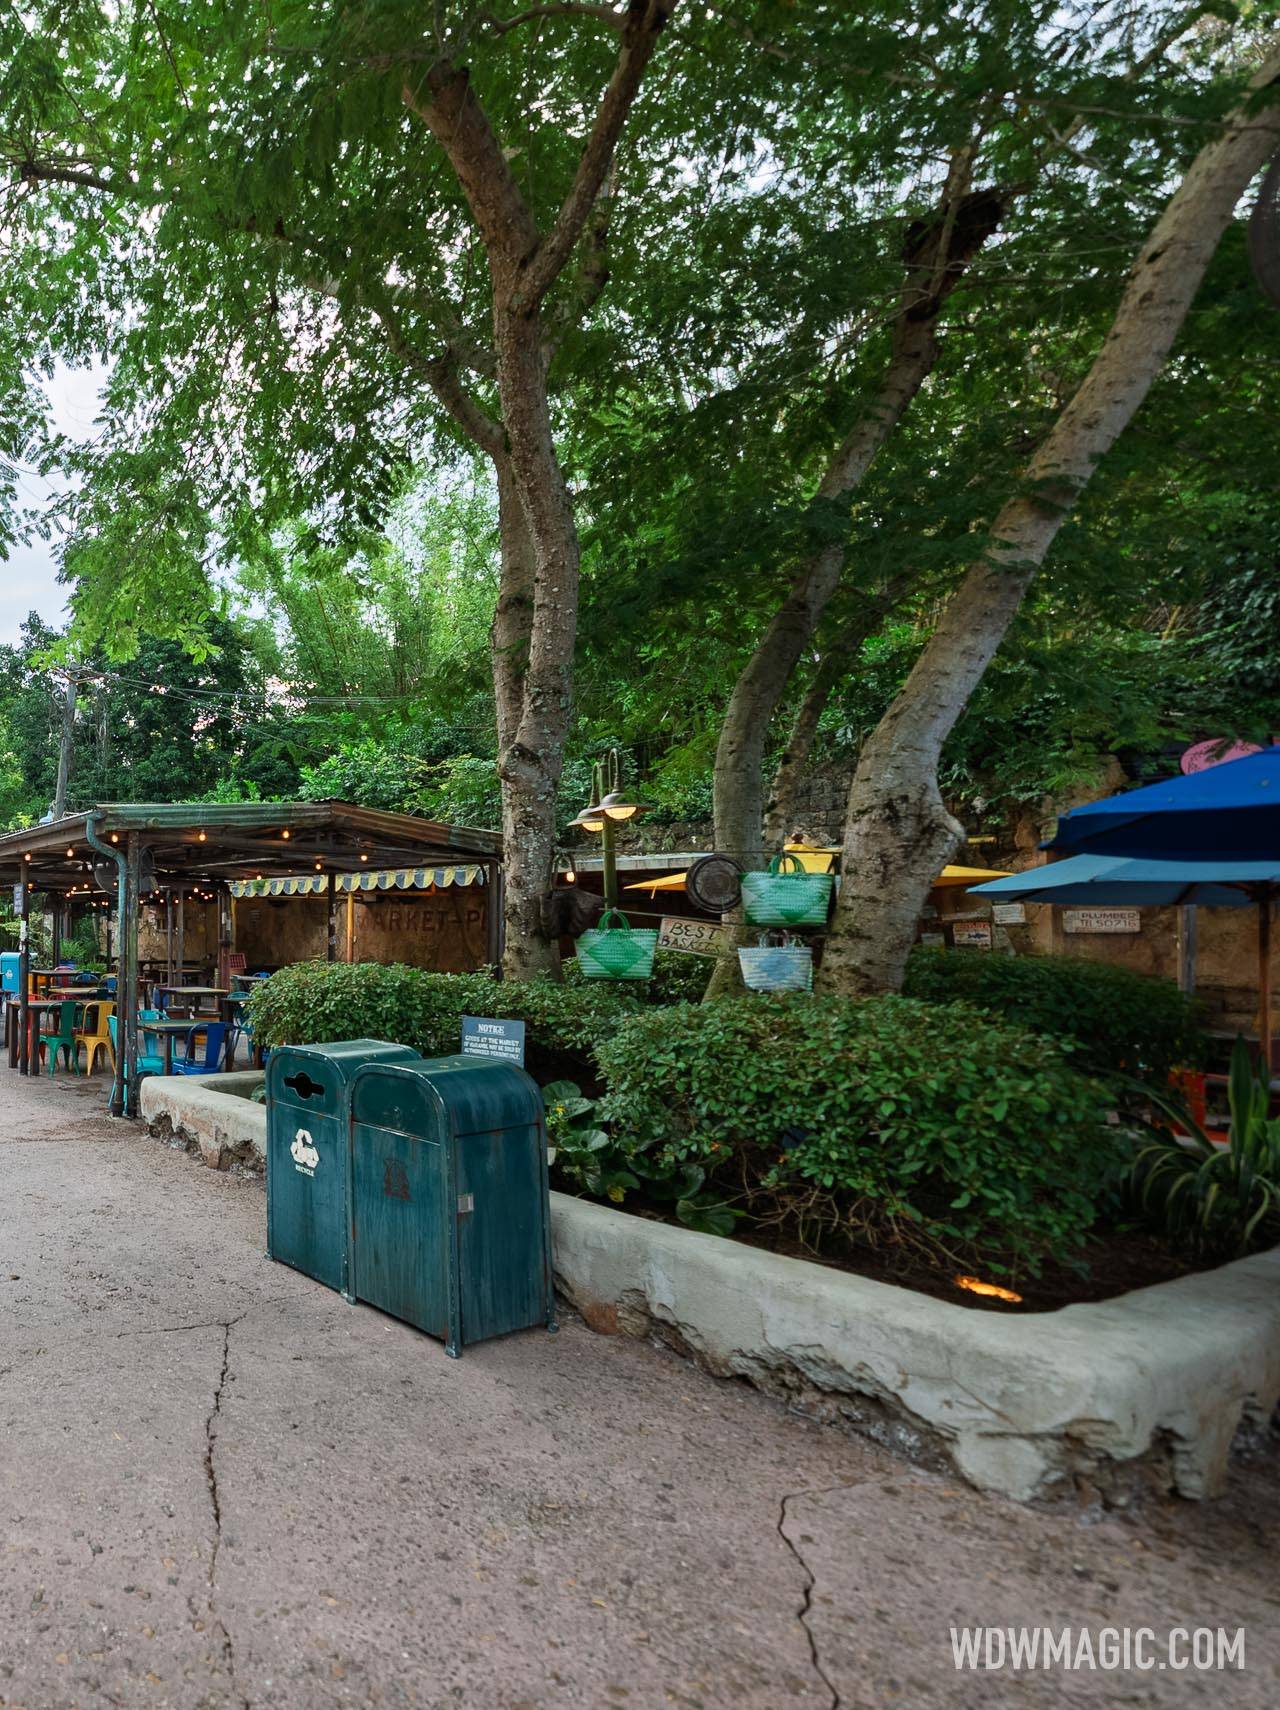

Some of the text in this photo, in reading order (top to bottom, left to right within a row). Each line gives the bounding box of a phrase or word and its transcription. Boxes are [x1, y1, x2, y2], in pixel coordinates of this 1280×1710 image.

[1081, 911, 1137, 920] PLUMBER
[670, 922, 723, 940] BEST
[478, 1023, 505, 1034] NOTICE
[295, 1163, 314, 1177] RECYCLE
